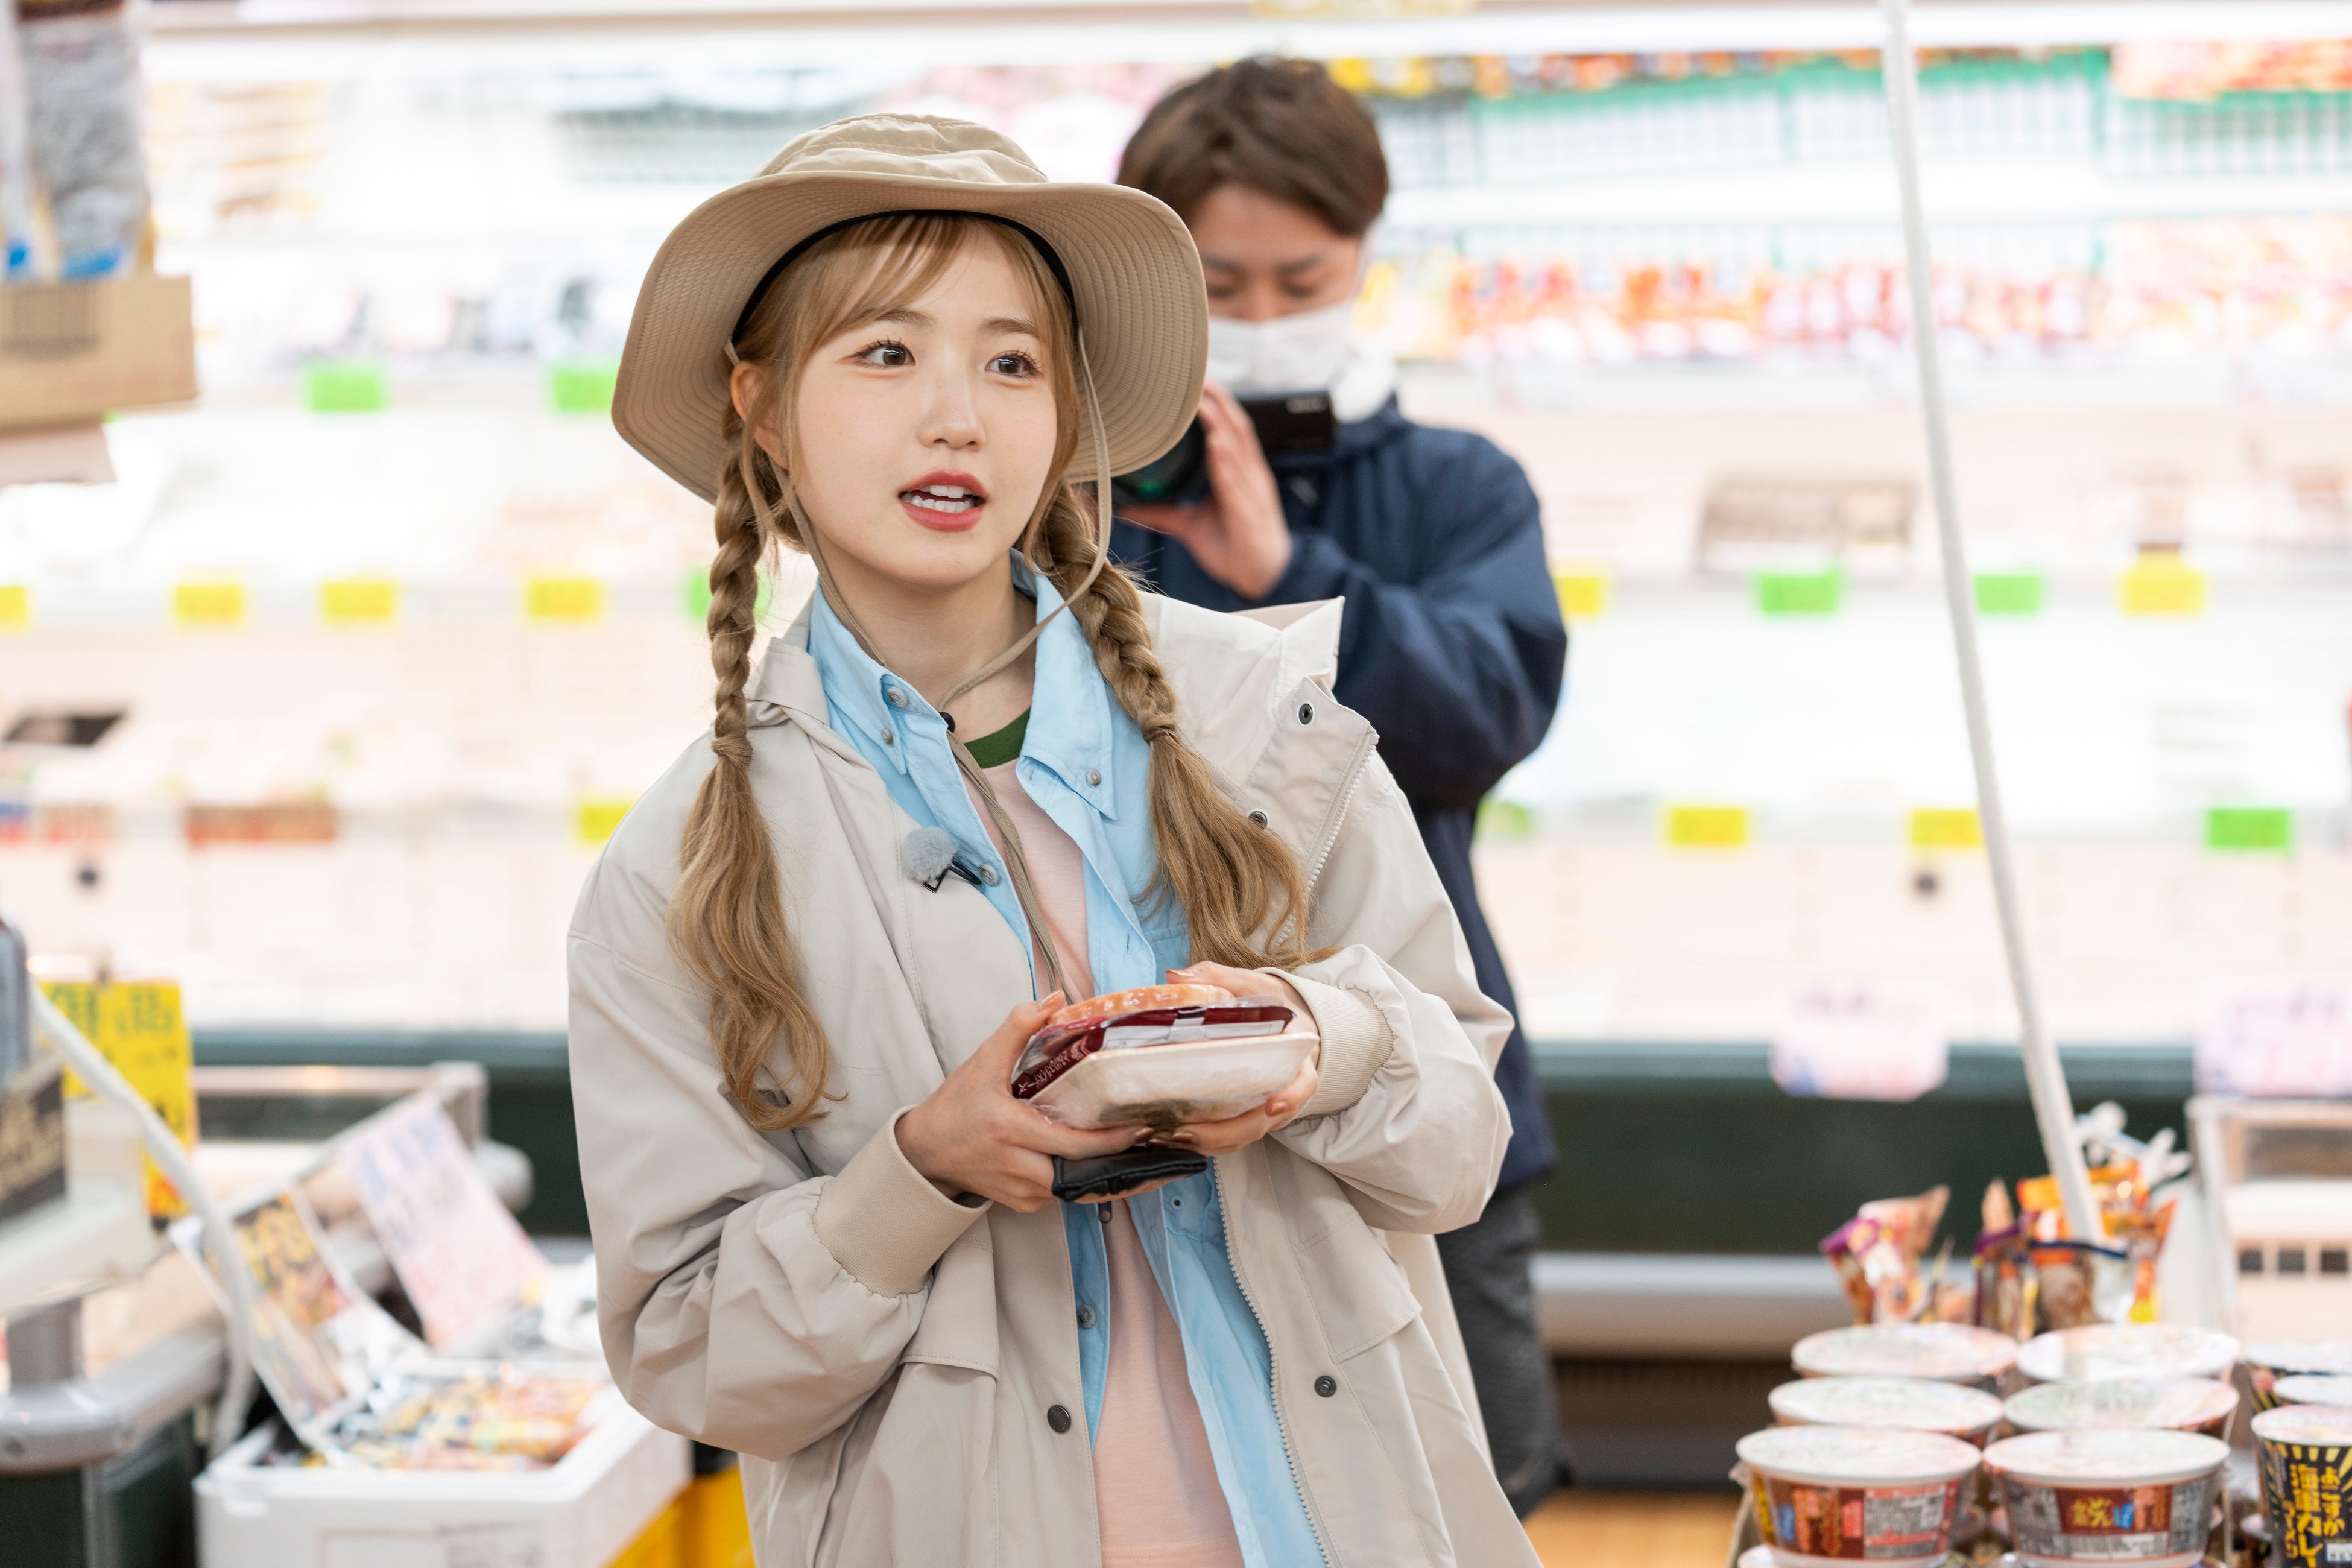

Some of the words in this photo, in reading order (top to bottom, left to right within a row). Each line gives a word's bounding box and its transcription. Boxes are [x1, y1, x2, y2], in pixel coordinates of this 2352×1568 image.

[1017, 1050, 1070, 1096] とろけるスライスチーズ
[2321, 1466, 2345, 1537] よこすか
